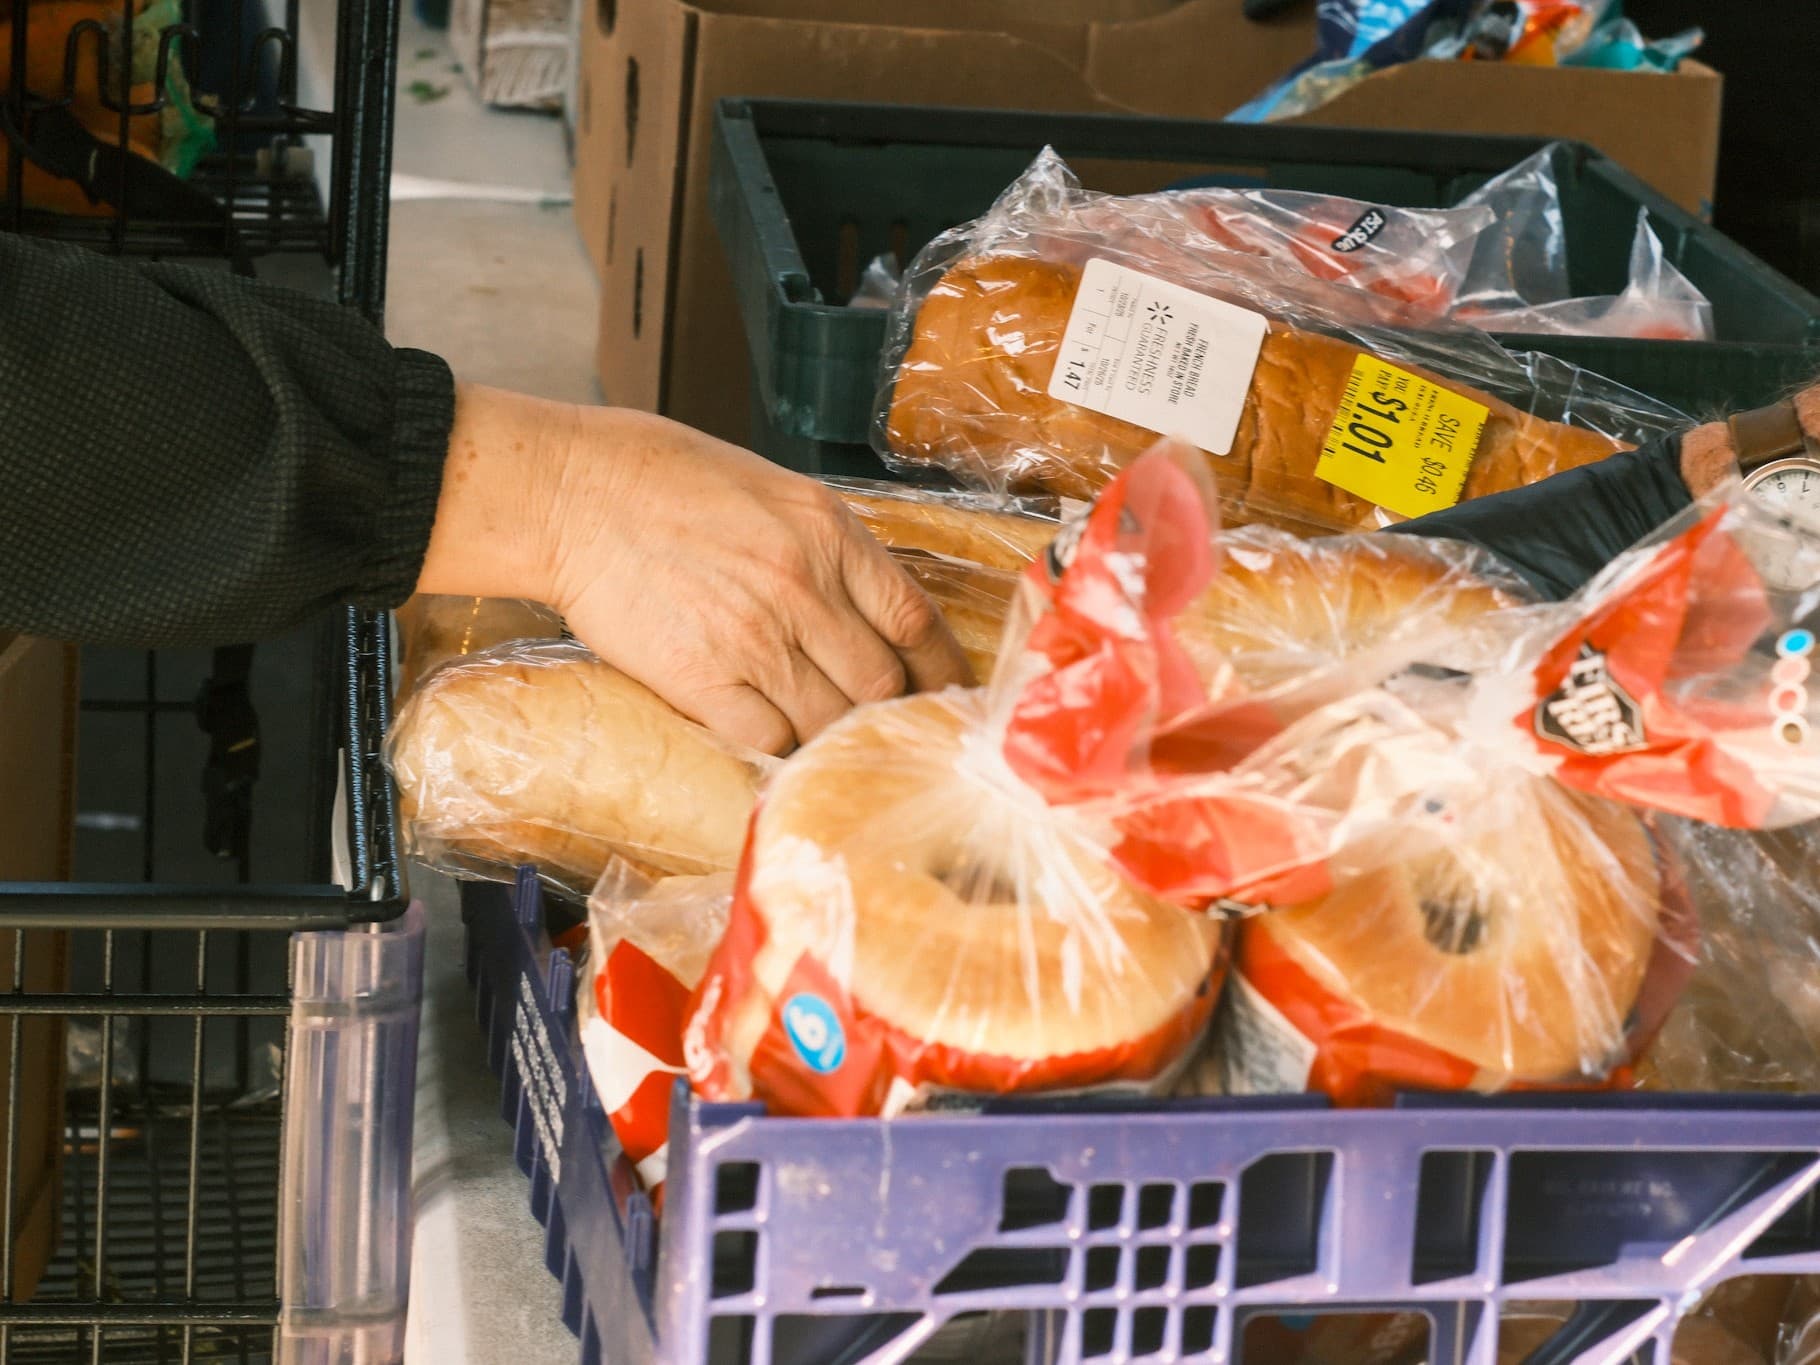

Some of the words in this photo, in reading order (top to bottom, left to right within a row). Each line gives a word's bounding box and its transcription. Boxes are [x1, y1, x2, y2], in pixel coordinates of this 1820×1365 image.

[1183, 322, 1199, 346] FRESH
[1123, 321, 1153, 391] GUARANTEED
[1138, 327, 1168, 395] FRESHNESS
[1176, 346, 1192, 371] BAKED
[1190, 338, 1209, 370] FRENCH
[1062, 358, 1086, 390] 1.47
[1174, 370, 1185, 380] IN
[1182, 370, 1200, 398] BREAD
[1376, 369, 1392, 390] PAY
[1394, 376, 1409, 393] YOU
[1166, 379, 1182, 405] STORE
[1342, 391, 1408, 464] $1.01
[1430, 413, 1460, 452] SAVE
[1415, 457, 1447, 495] $0.46
